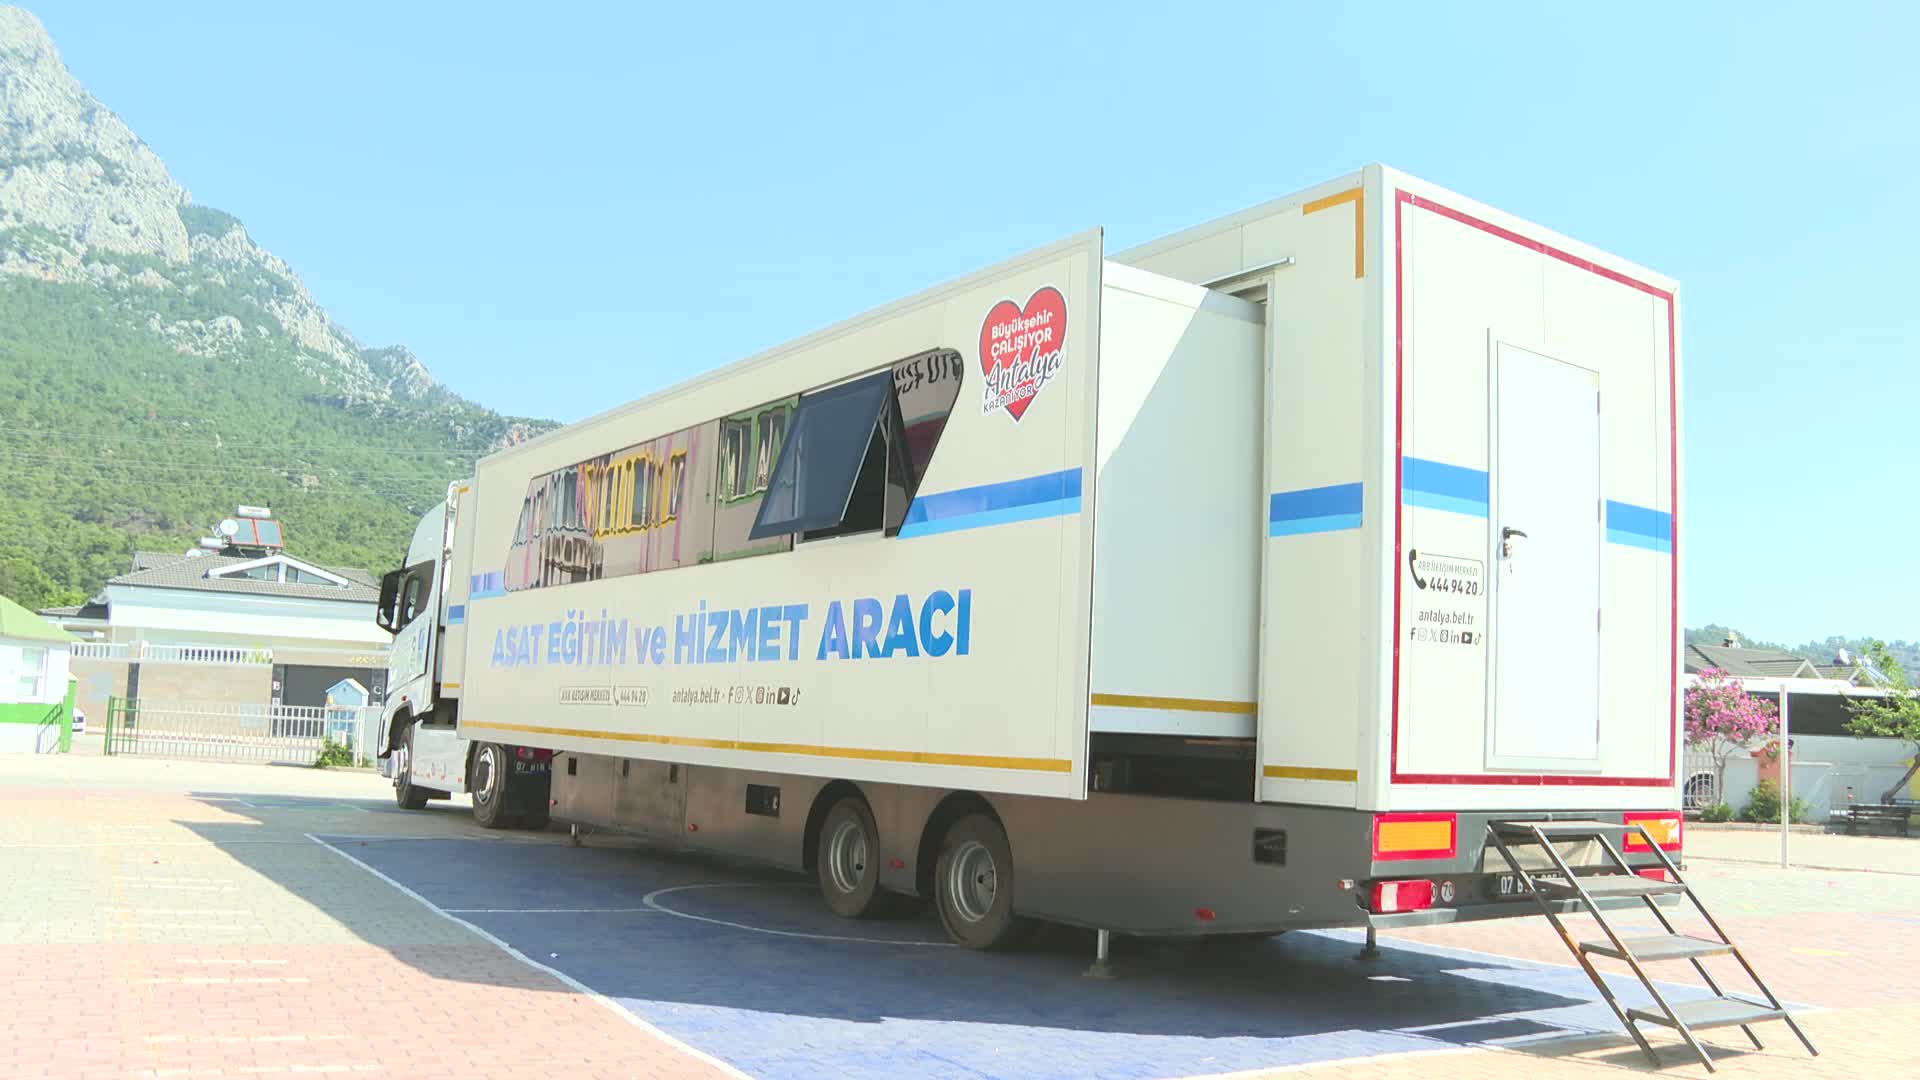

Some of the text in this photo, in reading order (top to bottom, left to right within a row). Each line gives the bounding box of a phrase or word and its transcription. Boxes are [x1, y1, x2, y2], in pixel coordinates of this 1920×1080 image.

[991, 309, 1053, 340] Büyükşehir
[991, 327, 1053, 360] ÇALIŞIYOR
[985, 345, 1064, 395] Antalya
[983, 385, 1033, 413] KAZANIYOR
[1430, 577, 1478, 596] 444 94 20
[491, 623, 544, 667] ASAT
[547, 608, 628, 664] EĞİTİM
[634, 625, 667, 664] ve
[674, 600, 809, 665] HİZMET
[816, 589, 972, 660] ARACI
[1418, 609, 1474, 625] antalya.bel.tr
[672, 686, 720, 706] antalya.bel.tr
[1443, 884, 1454, 897] 70
[1501, 876, 1513, 894] 07
